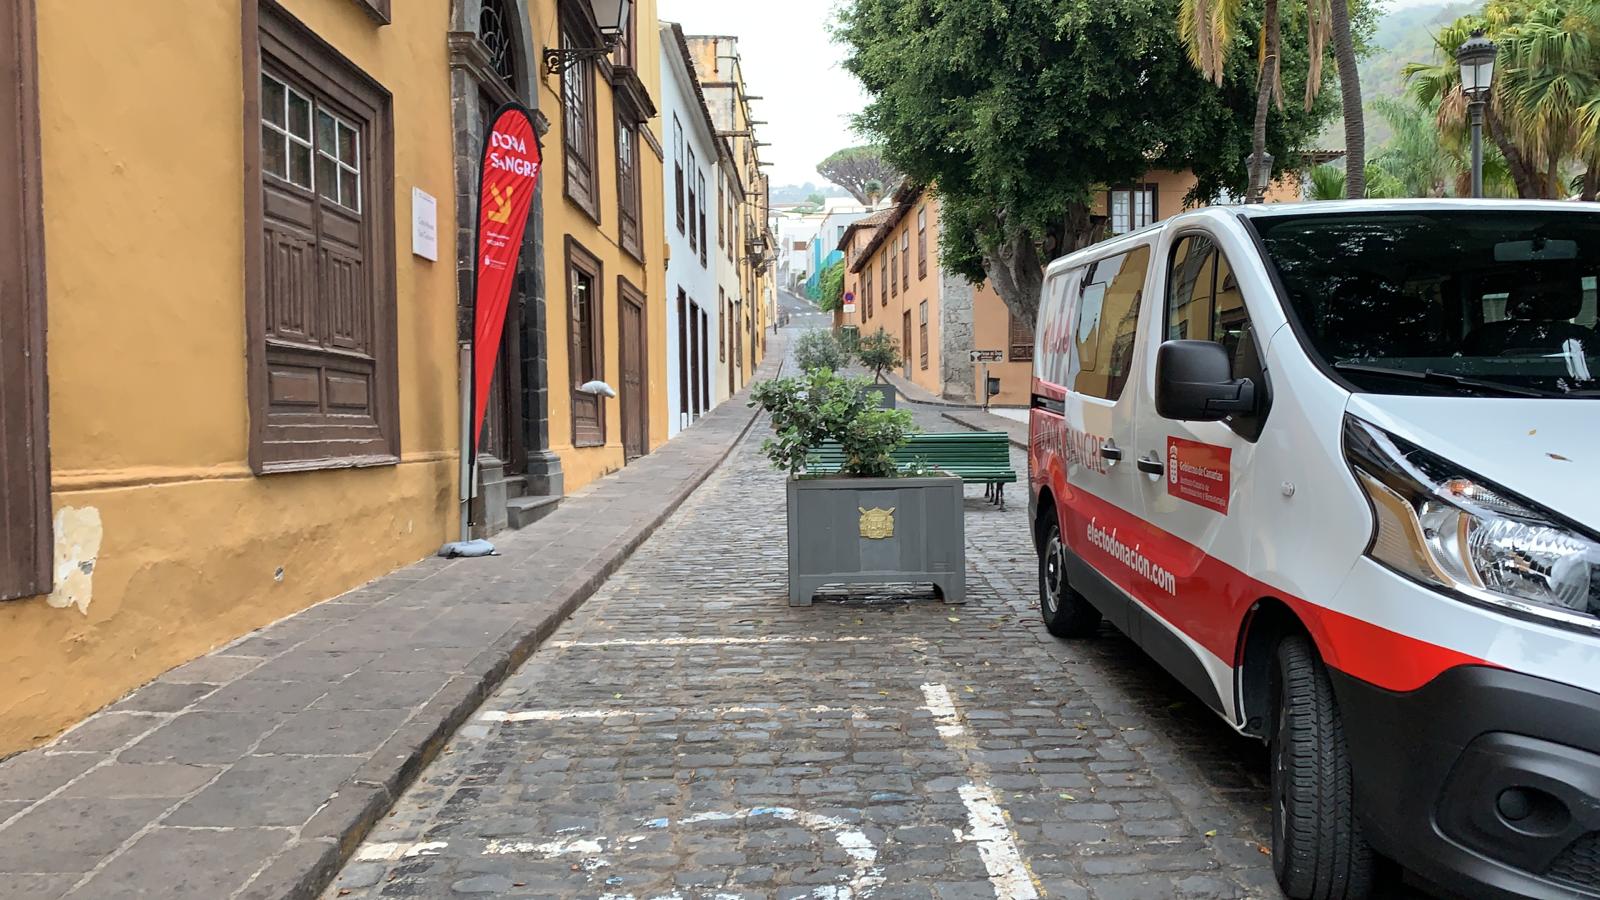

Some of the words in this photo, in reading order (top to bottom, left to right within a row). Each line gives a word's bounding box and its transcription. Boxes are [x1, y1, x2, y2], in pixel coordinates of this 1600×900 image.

[491, 130, 527, 155] DONA
[490, 152, 539, 178] SANGRE
[1065, 427, 1106, 476] SANGRE
[1180, 461, 1198, 476] Gobierno
[1203, 467, 1223, 482] Canarias
